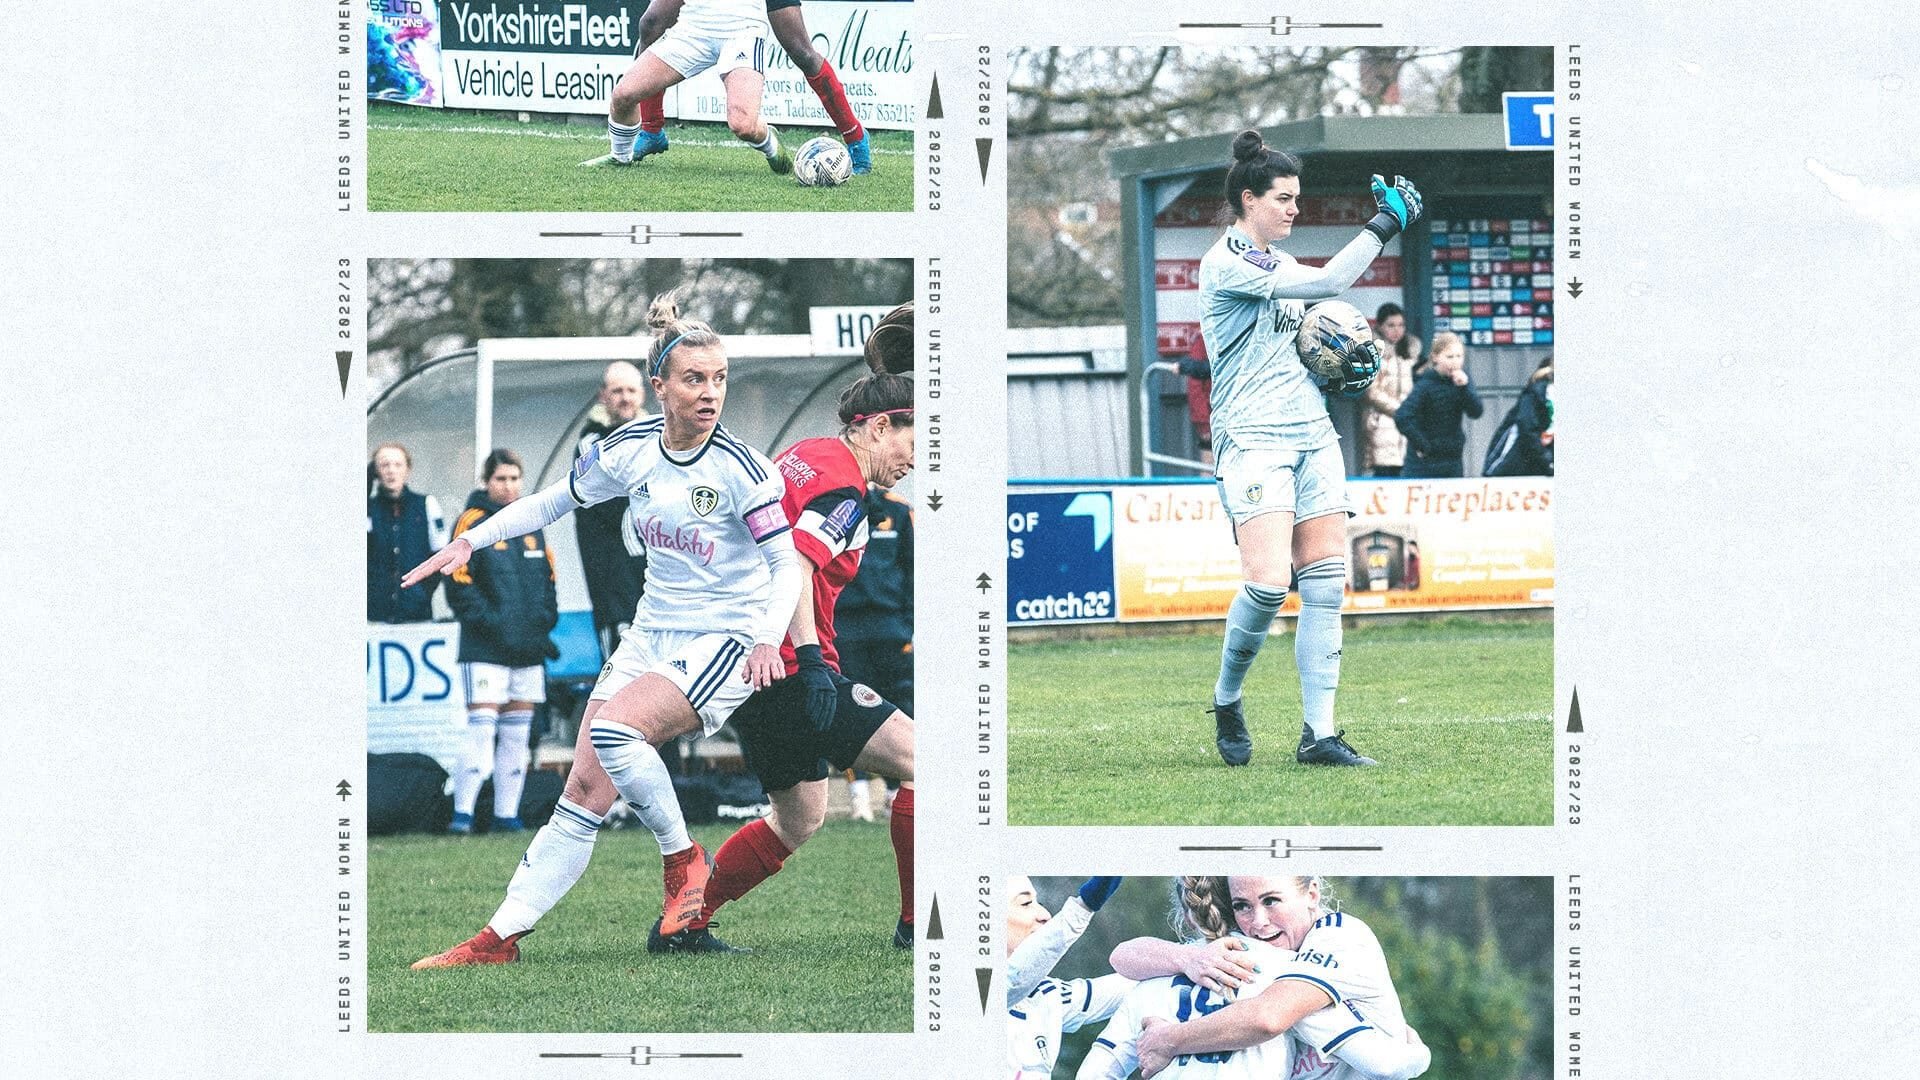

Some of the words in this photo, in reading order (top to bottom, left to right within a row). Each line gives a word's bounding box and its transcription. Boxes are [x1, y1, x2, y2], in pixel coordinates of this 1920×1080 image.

[452, 2, 631, 47] YorkshireFleet
[454, 58, 533, 98] Vehicle
[697, 96, 708, 113] 10
[711, 96, 727, 114] Bri
[837, 314, 885, 348] HO
[1364, 486, 1388, 515] &
[1406, 484, 1552, 522] Fireplaces
[1008, 512, 1040, 533] OF
[637, 515, 715, 567] Vitality
[1016, 591, 1111, 620] catch22
[367, 640, 452, 703] DS
[1290, 949, 1339, 968] rish
